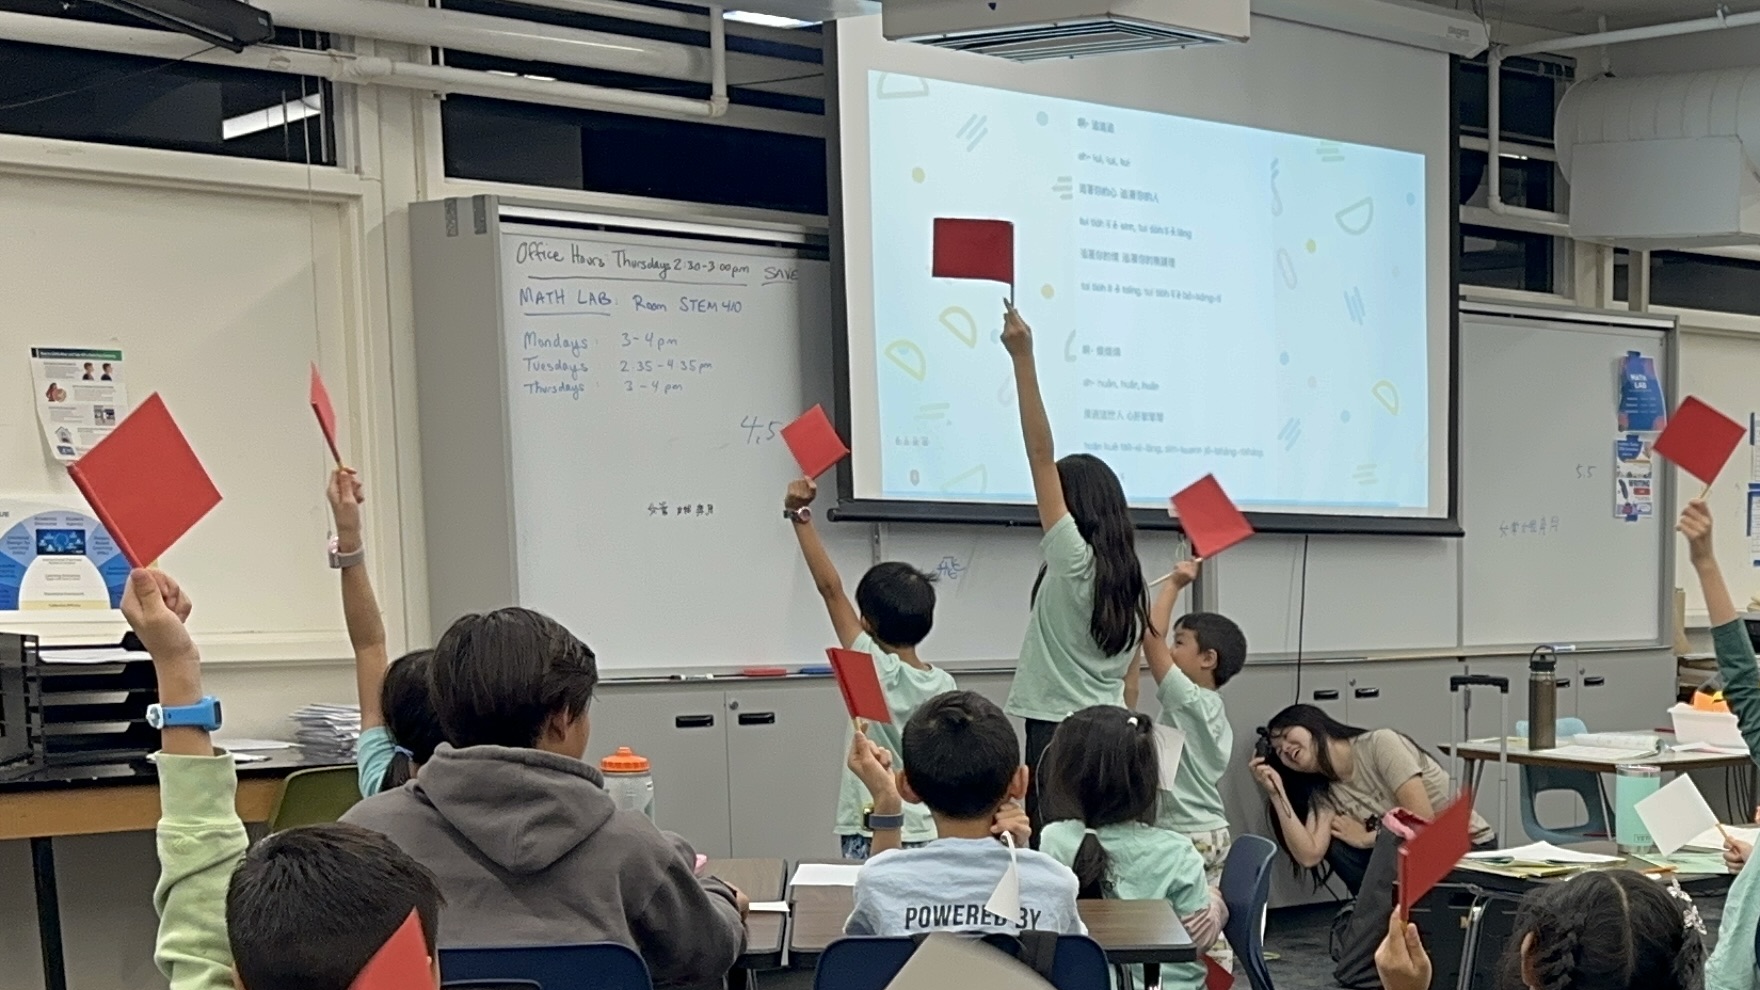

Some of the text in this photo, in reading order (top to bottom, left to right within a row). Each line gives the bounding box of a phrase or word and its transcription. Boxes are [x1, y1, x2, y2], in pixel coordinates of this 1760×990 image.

[516, 241, 564, 264] Office
[571, 243, 605, 268] Hours
[611, 249, 671, 280] Thursdays
[763, 266, 799, 281] SAVE
[519, 287, 565, 306] MATH
[632, 294, 667, 312] Room
[523, 356, 589, 381] Tuesdays
